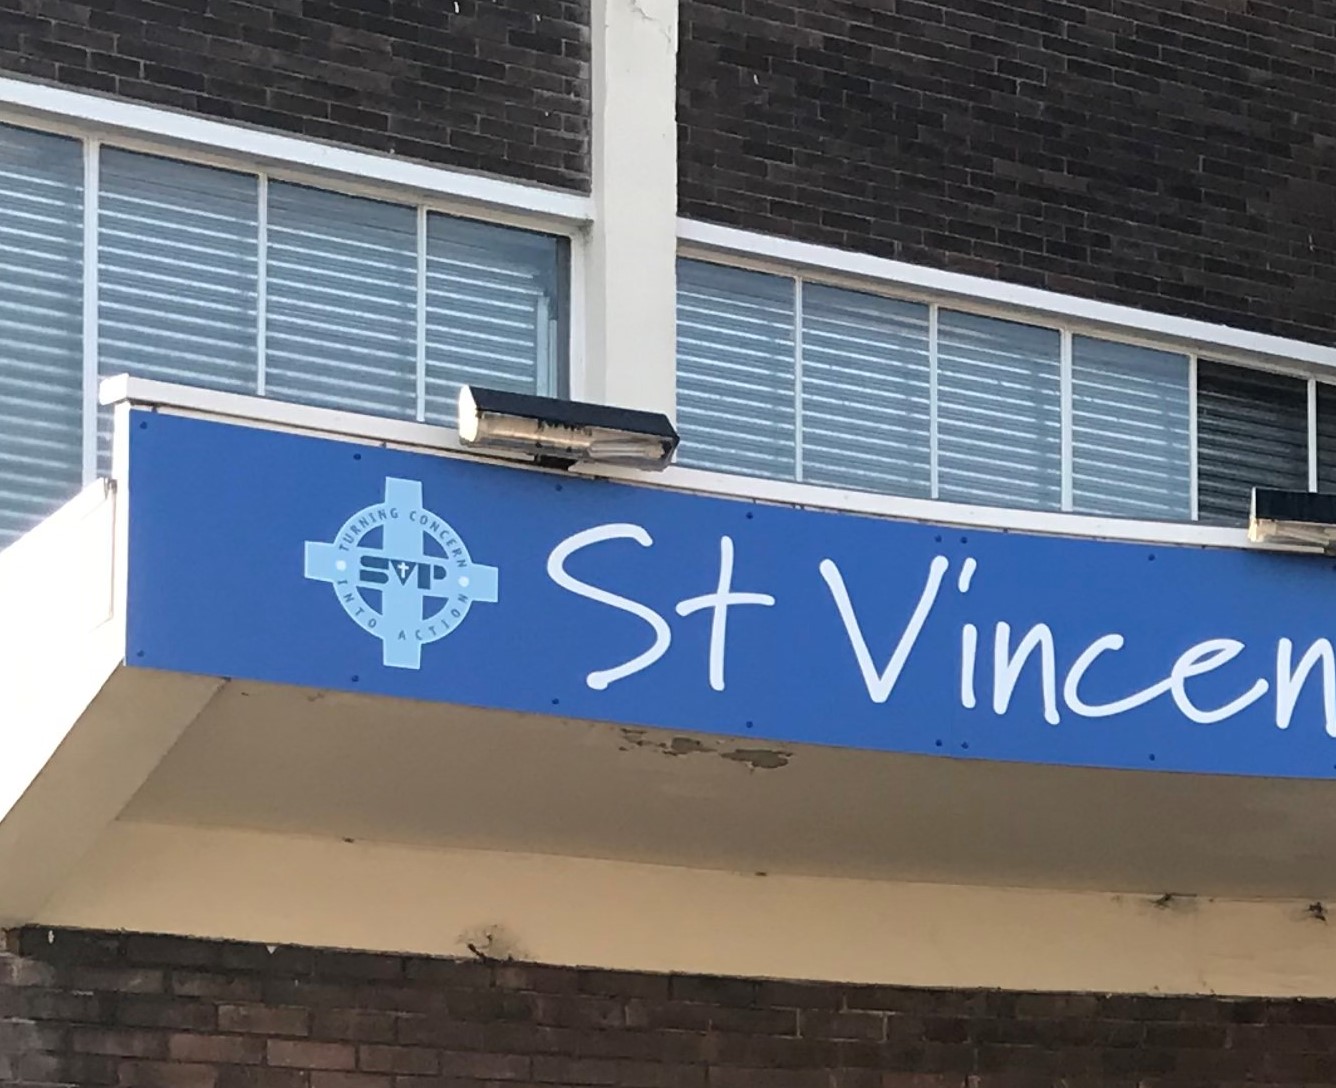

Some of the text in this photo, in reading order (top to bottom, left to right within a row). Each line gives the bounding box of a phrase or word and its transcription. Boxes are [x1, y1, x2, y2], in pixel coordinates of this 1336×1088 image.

[339, 507, 468, 568] TURNING CONCERN
[360, 555, 447, 590] SVP
[337, 579, 469, 641] INTO ACTION
[546, 522, 776, 691] St
